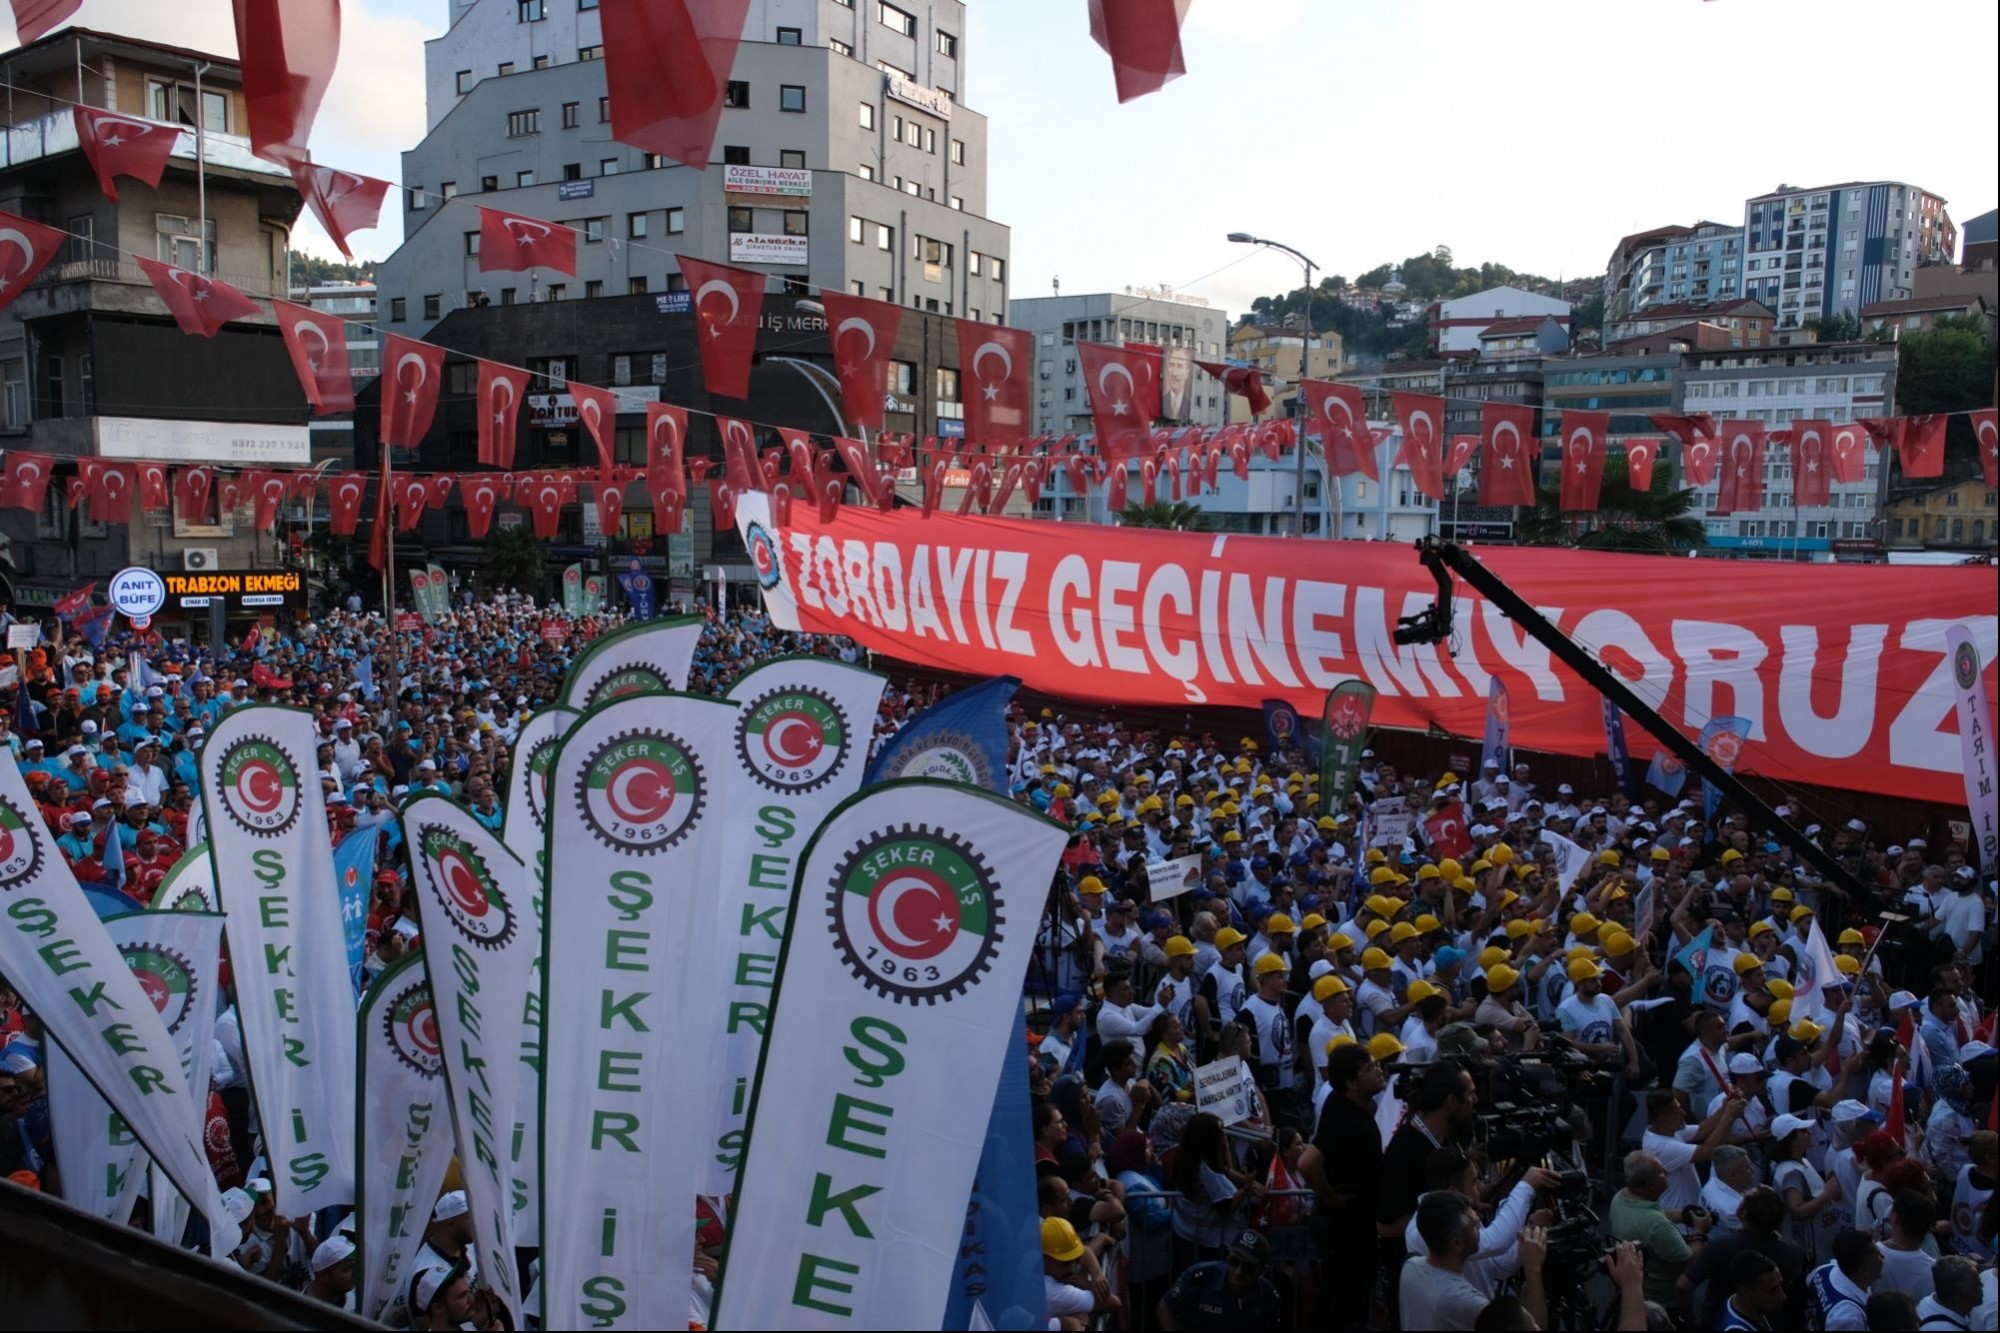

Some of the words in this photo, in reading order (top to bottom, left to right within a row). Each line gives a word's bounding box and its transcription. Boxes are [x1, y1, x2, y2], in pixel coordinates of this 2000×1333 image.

[730, 166, 764, 179] ÖZEL
[768, 170, 808, 180] HAYAT
[745, 178, 777, 187] DANIŞMA
[768, 313, 784, 332] İŞ
[120, 581, 154, 591] ANIT
[166, 575, 241, 594] TRABZON
[245, 572, 300, 592] EKMEĞİ
[790, 532, 1037, 657] ZORDAYIZ
[120, 593, 156, 605] BÜFE
[599, 674, 637, 701] ŞEKER
[755, 699, 803, 723] ŞEKER
[823, 707, 837, 731] İŞ
[225, 746, 259, 776] ŞEKER
[274, 755, 287, 775] İŞ
[595, 743, 650, 775] ŞEKER
[670, 755, 688, 777] İŞ
[892, 748, 914, 773] GIDA
[933, 735, 979, 760] YARDIMCI
[764, 766, 816, 782] 1963
[243, 809, 286, 826] 1963
[609, 820, 670, 841] 1963
[428, 831, 462, 854] ŞEKER
[861, 846, 936, 881] ŞEKER
[959, 879, 982, 906] İŞ
[445, 898, 490, 935] 1963
[727, 804, 796, 1036] ŞEKER
[866, 945, 941, 984] 1963
[7, 897, 176, 1097] ŞEKER
[589, 869, 655, 1154] ŞEKER
